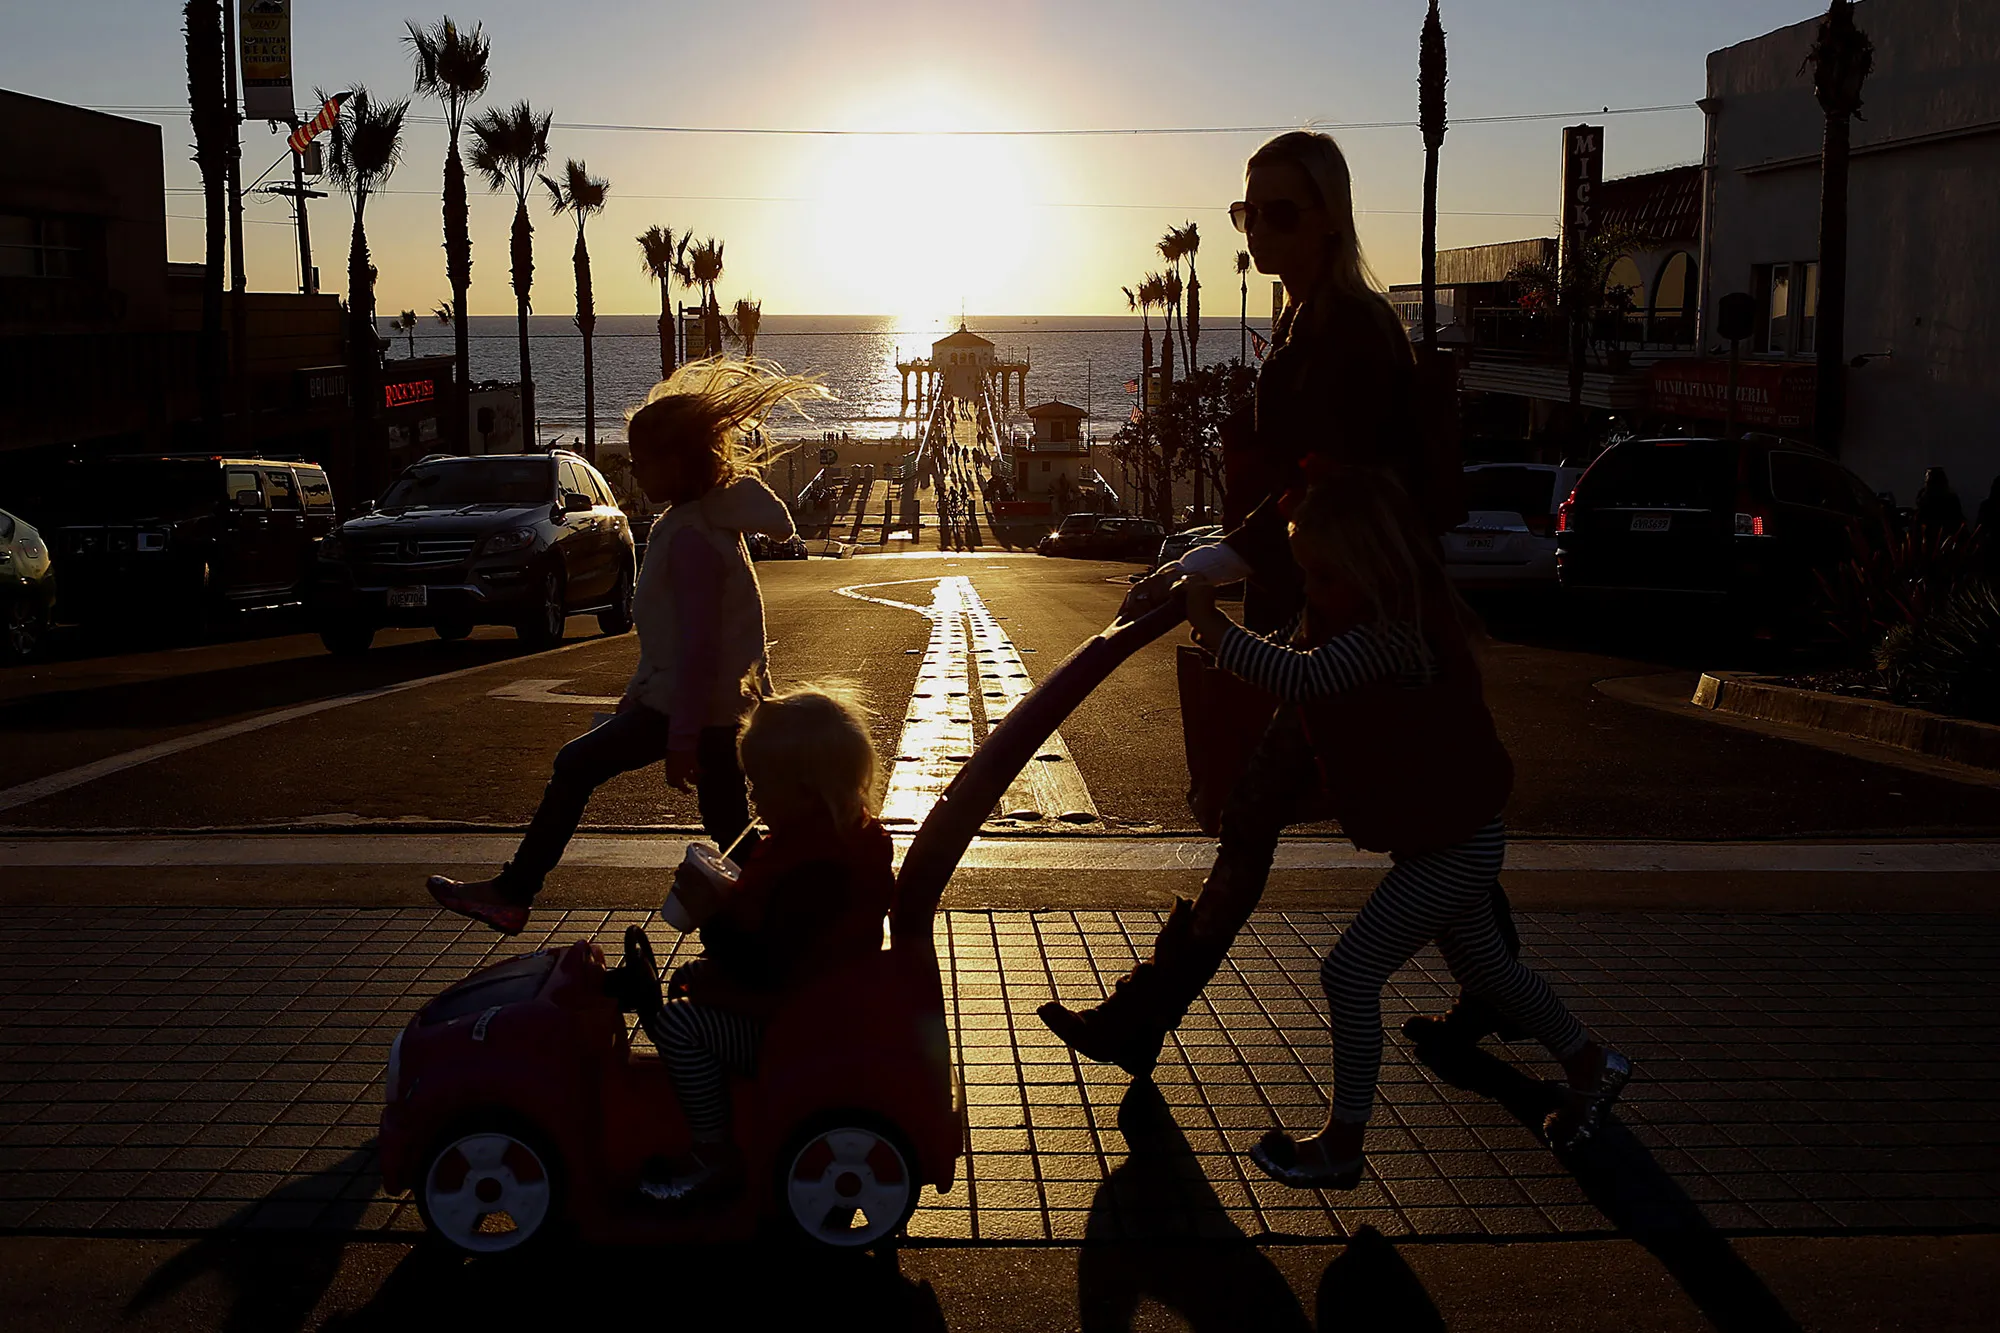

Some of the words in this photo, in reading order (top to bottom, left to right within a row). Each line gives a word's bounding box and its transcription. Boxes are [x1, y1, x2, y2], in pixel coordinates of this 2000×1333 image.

[244, 45, 287, 55] BEACH
[244, 56, 286, 64] CENTENNIAL
[1654, 379, 1716, 399] MANHATTAN
[1716, 385, 1769, 405] PIZERIA
